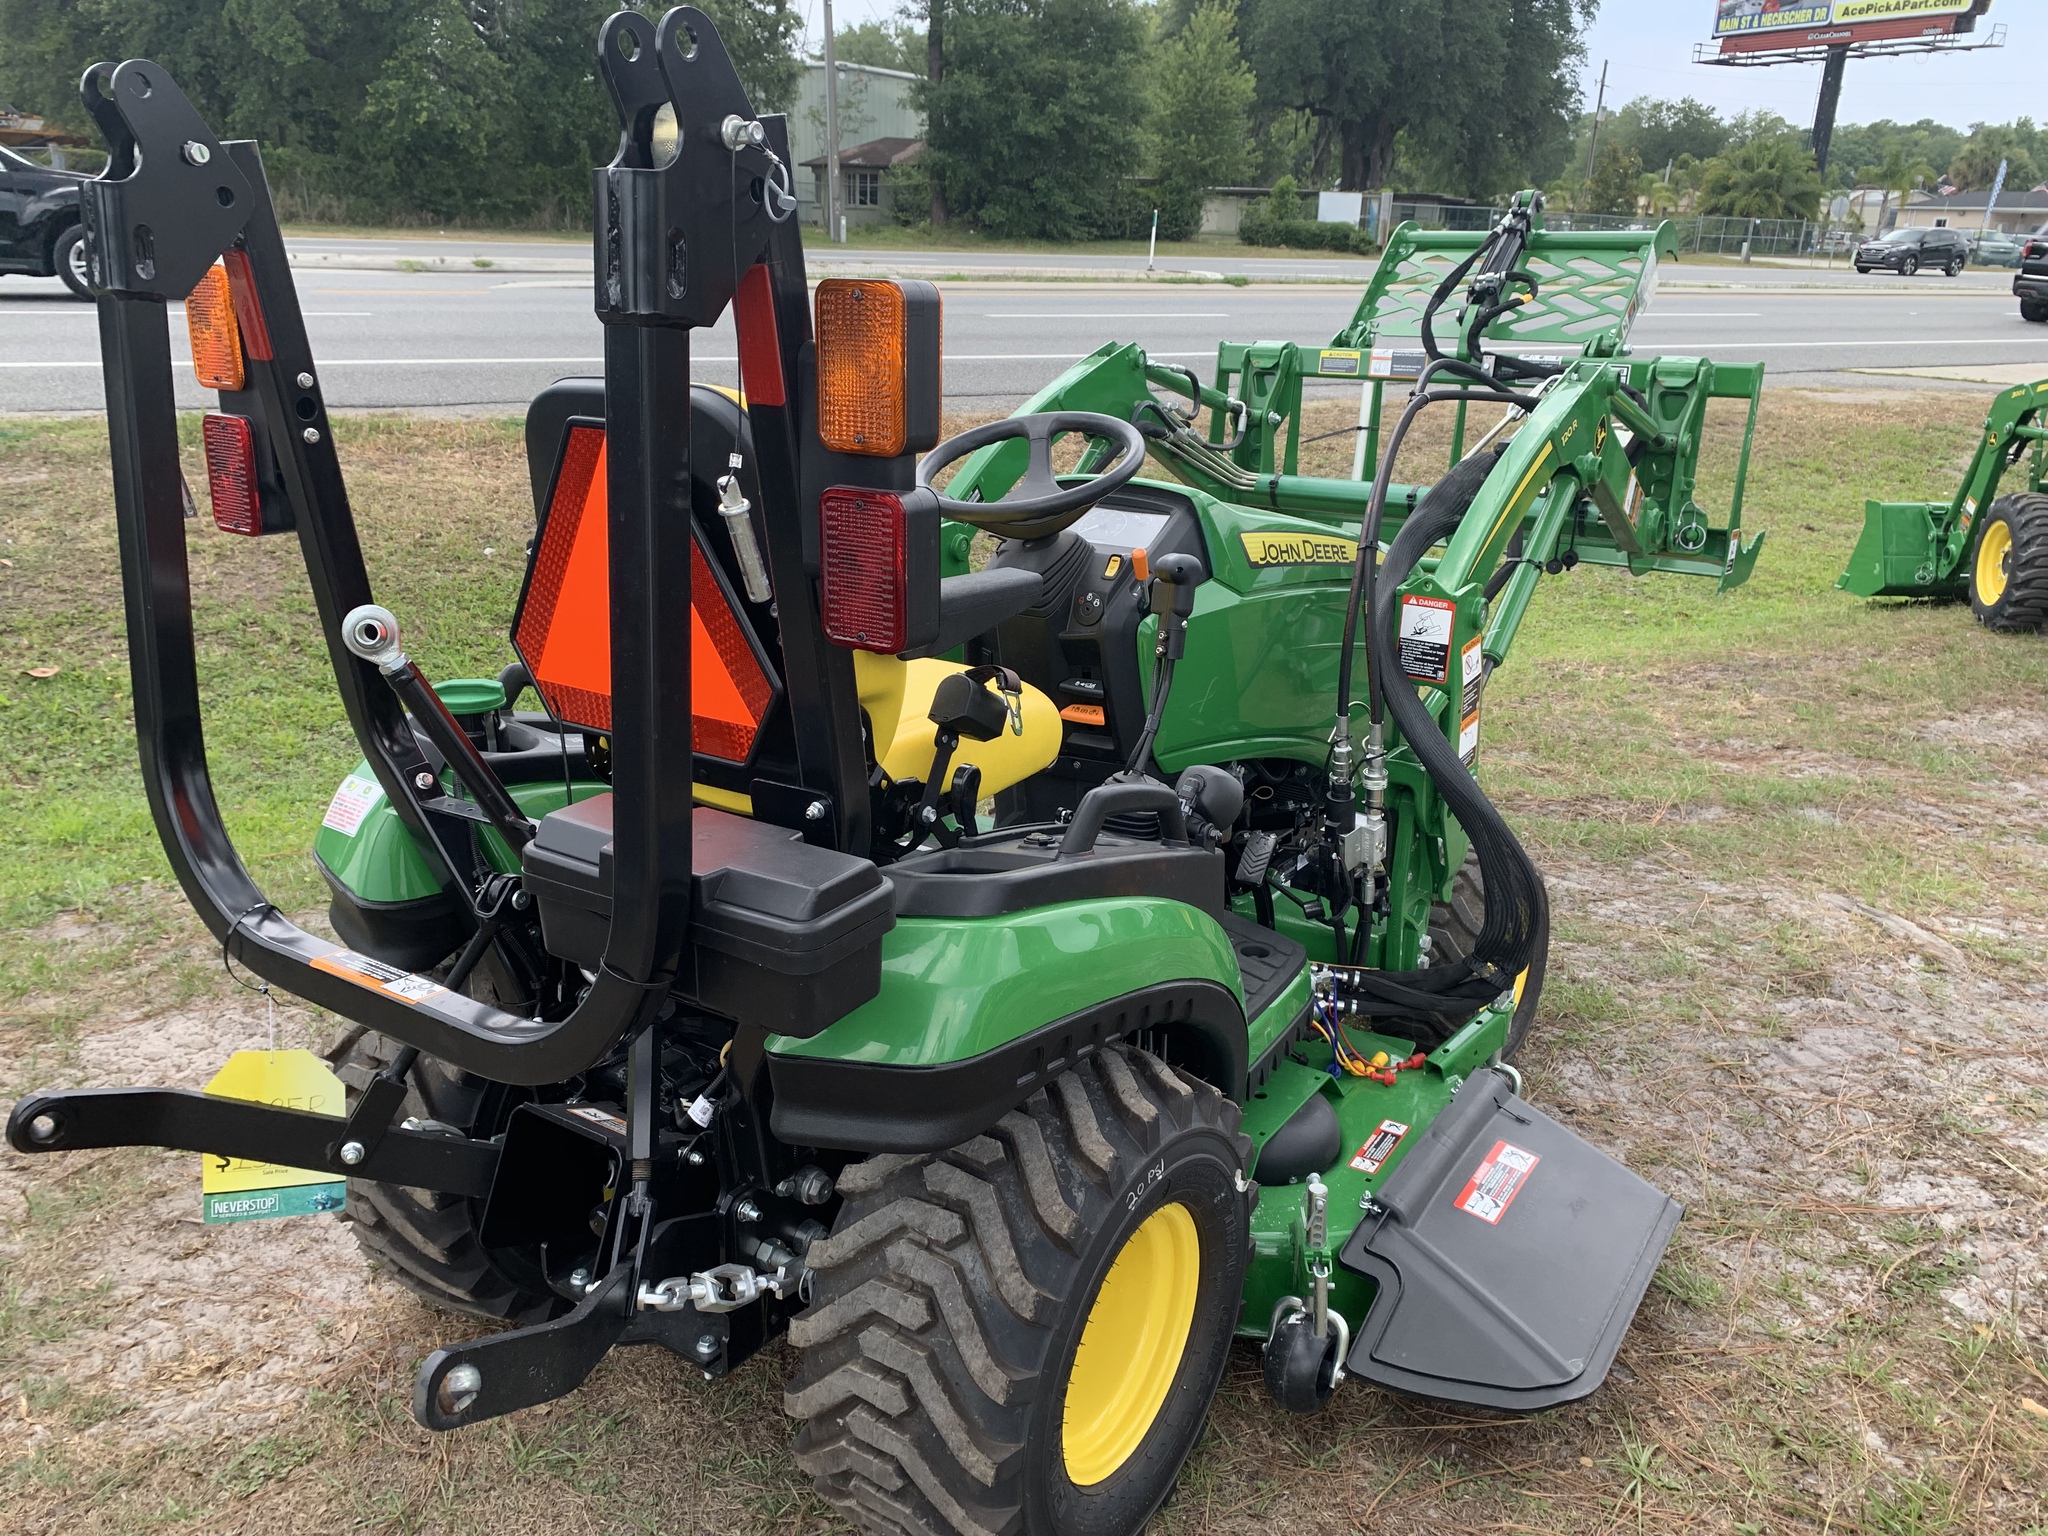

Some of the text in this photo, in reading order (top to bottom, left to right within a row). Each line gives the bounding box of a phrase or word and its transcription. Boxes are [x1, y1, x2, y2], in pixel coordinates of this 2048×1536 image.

[1842, 0, 1962, 16] AcePickAPart.com
[1719, 7, 1828, 31] MAIN ST & HECKSCHER DR
[1260, 540, 1349, 562] JOHN DEERE
[1419, 599, 1448, 609] DANGER
[215, 1198, 275, 1214] NEVERSTOP
[1126, 1183, 1145, 1211] 20
